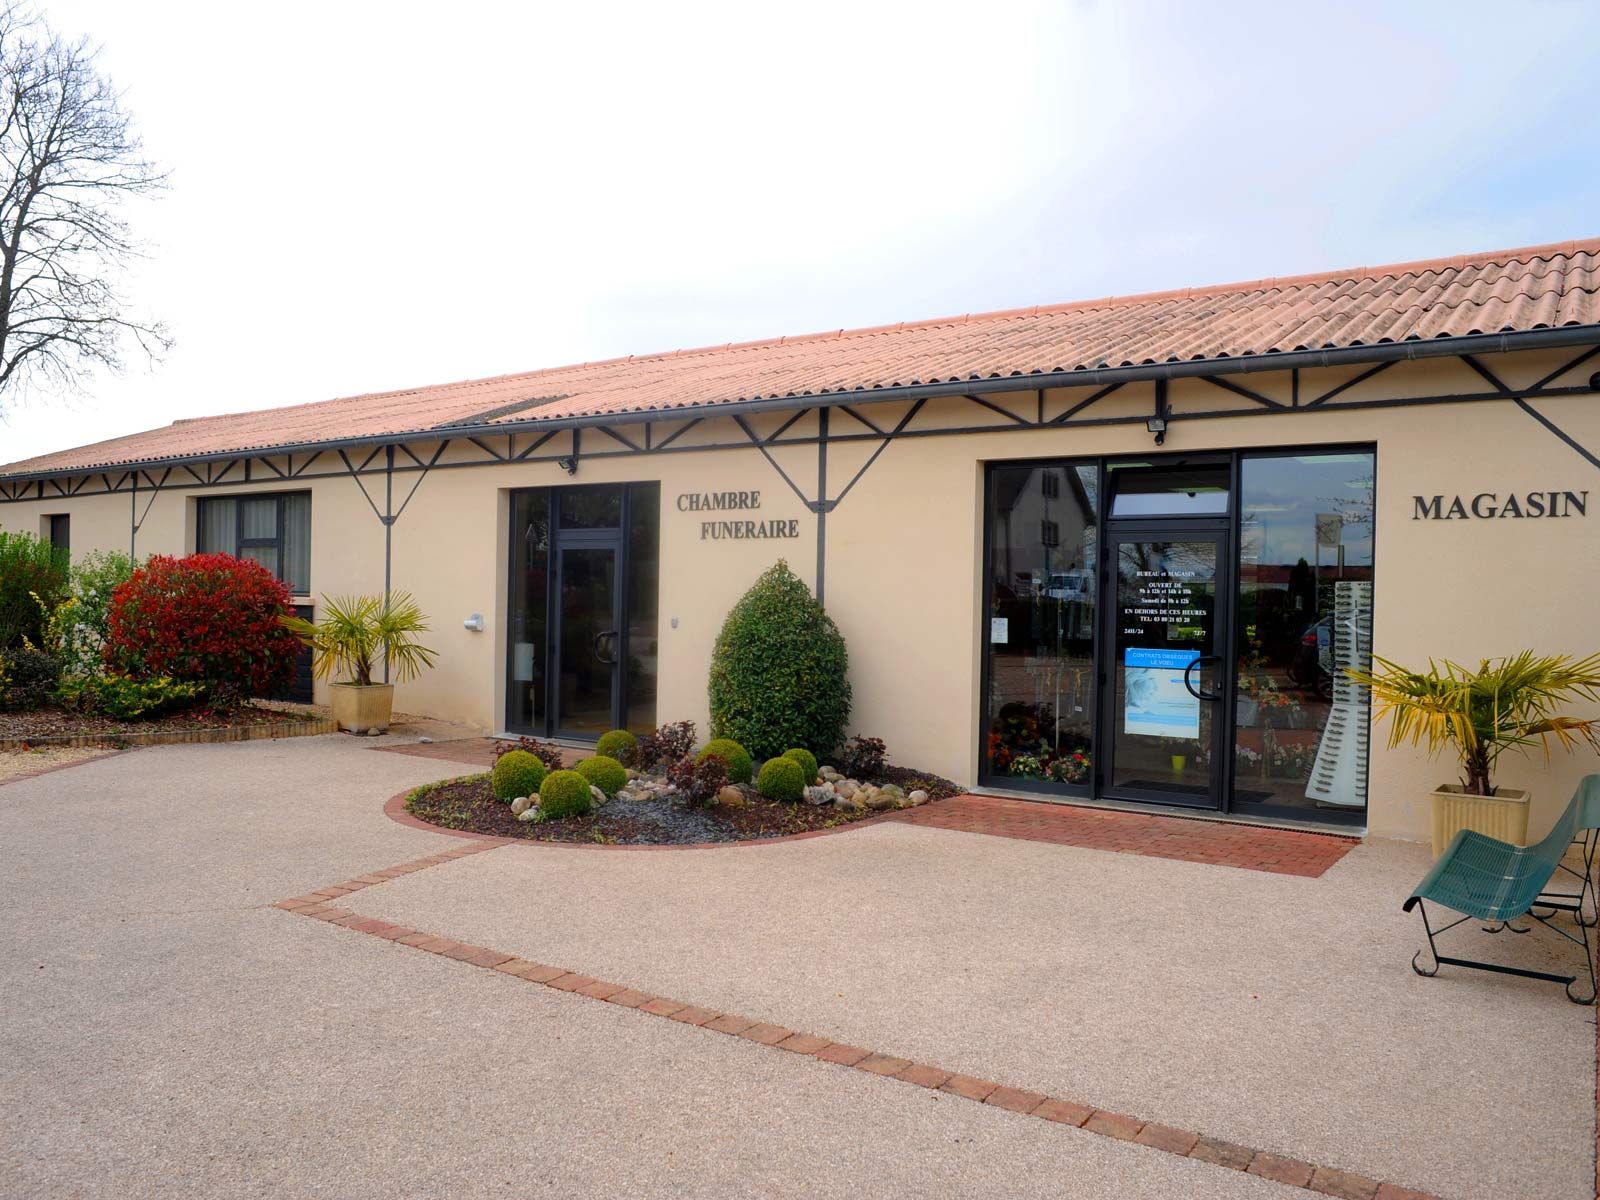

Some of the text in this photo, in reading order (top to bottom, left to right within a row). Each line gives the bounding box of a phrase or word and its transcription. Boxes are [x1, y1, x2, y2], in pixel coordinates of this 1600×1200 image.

[677, 491, 760, 511] CHAMBRE
[1412, 491, 1589, 520] MAGASIN
[701, 520, 799, 539] FUNERAIRE
